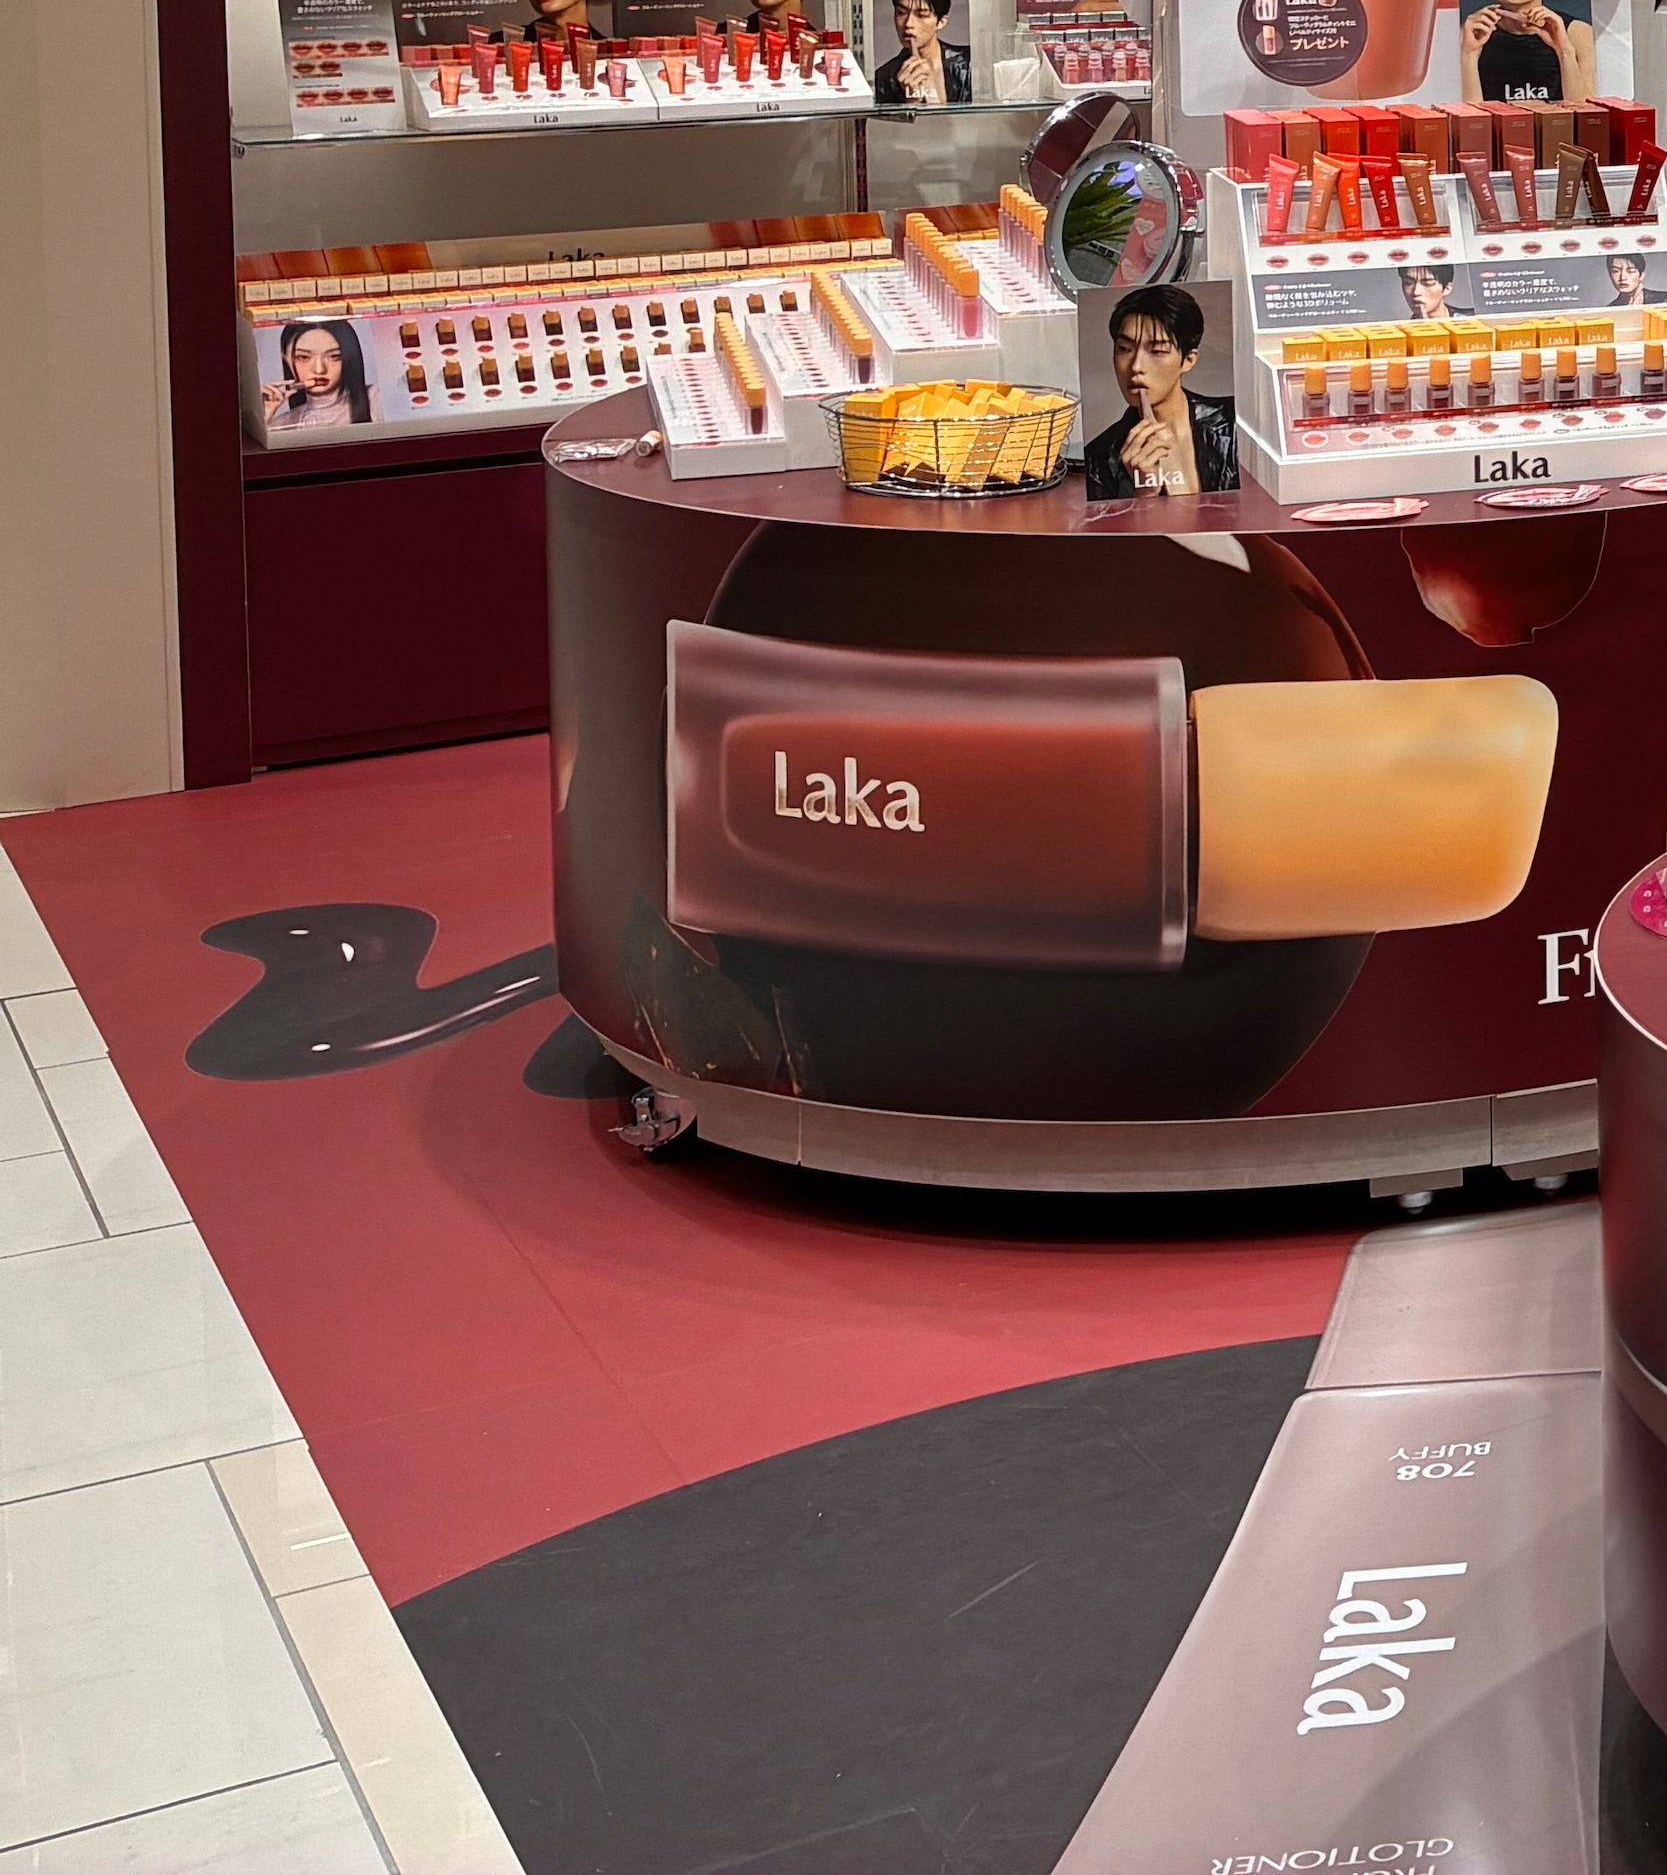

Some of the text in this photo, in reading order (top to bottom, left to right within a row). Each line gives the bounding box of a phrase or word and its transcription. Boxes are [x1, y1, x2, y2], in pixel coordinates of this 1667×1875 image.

[1290, 36, 1349, 51] プレゼント
[905, 85, 938, 101] Laka
[1504, 82, 1549, 102] Laka
[533, 113, 558, 124] Laka
[1134, 467, 1184, 489] Laka
[1474, 451, 1551, 483] Laka
[774, 749, 925, 833] Laka
[1389, 1440, 1491, 1462] BUFFY
[1397, 1462, 1475, 1481] 708
[1297, 1562, 1468, 1736] Laka
[1211, 1837, 1454, 1875] GLOTIONER
